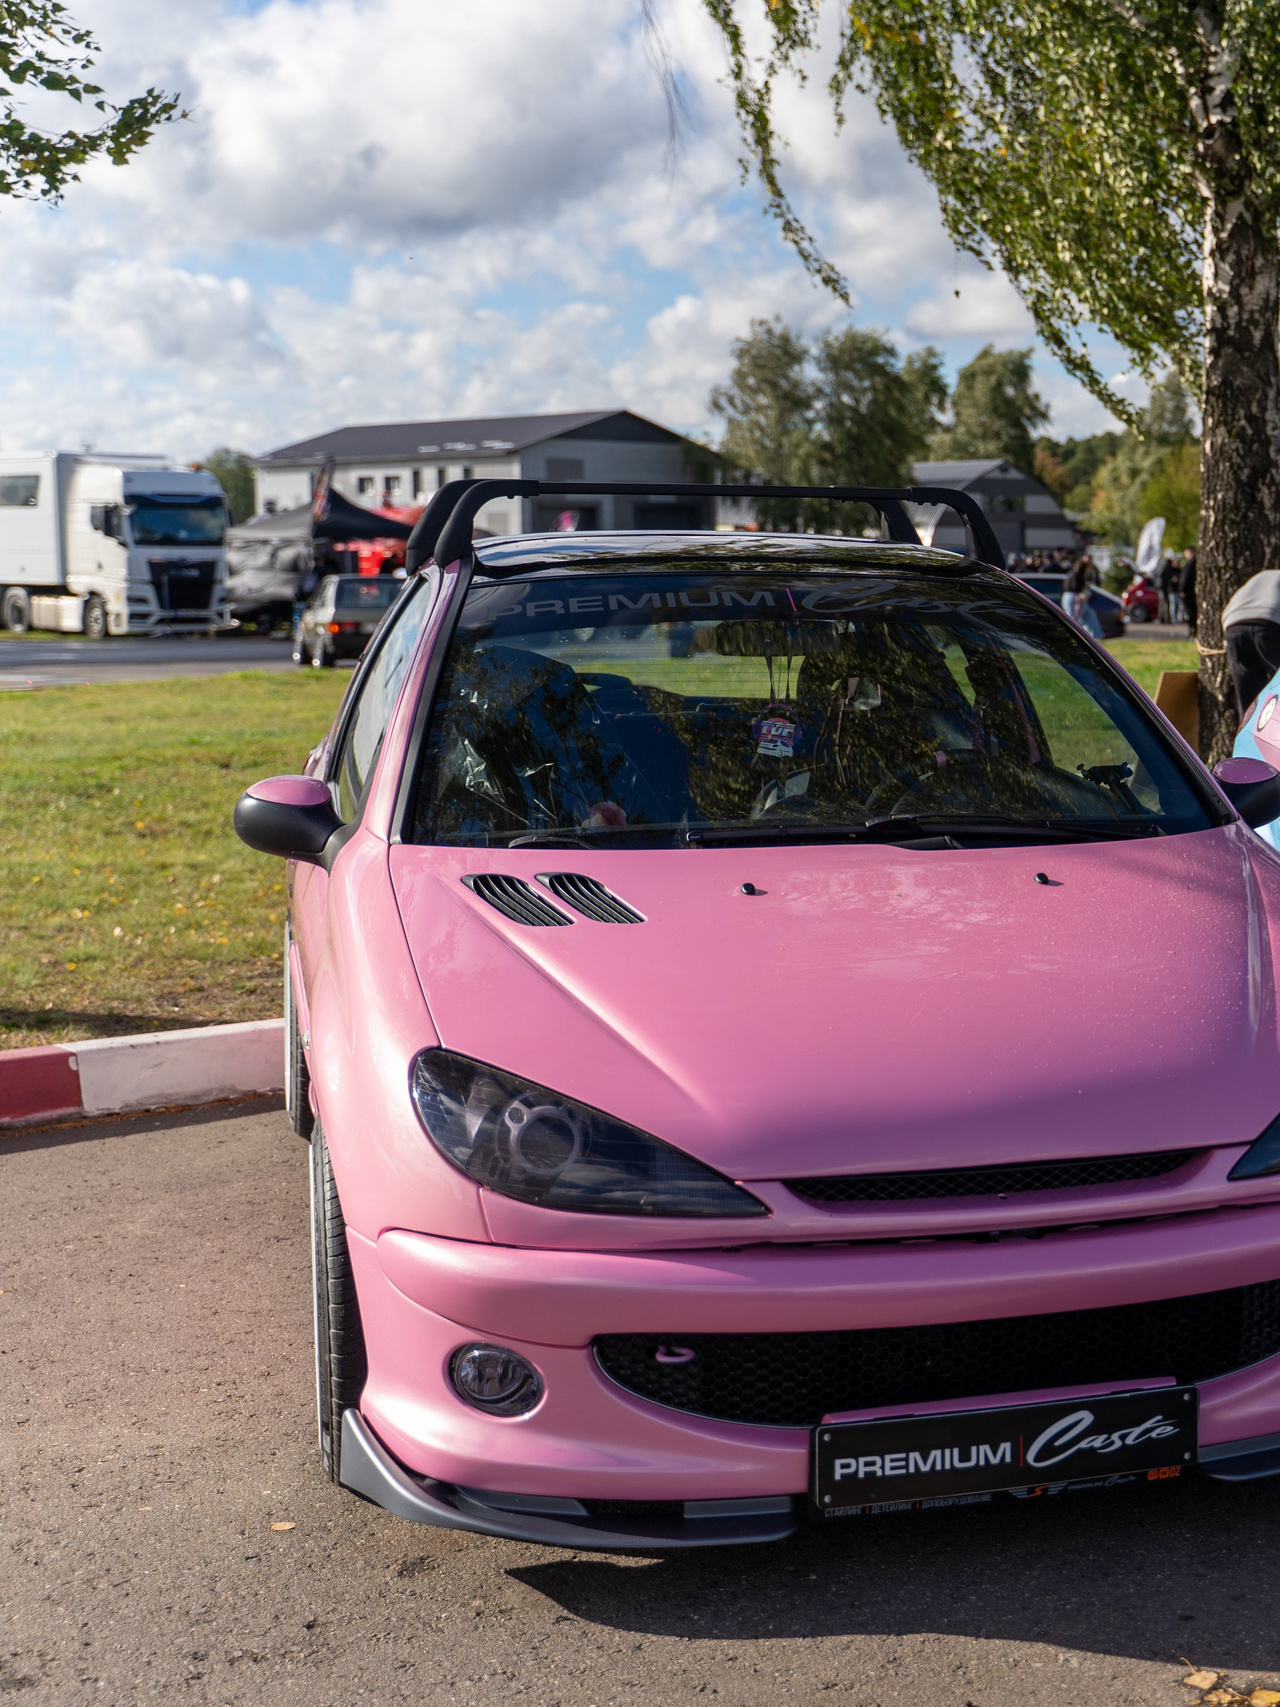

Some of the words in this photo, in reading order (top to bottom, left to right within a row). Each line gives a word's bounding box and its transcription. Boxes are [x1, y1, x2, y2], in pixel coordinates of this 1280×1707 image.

[487, 590, 776, 621] PREMIUM
[833, 1441, 1012, 1481] PREMIUM
[1026, 1409, 1181, 1468] Caste
